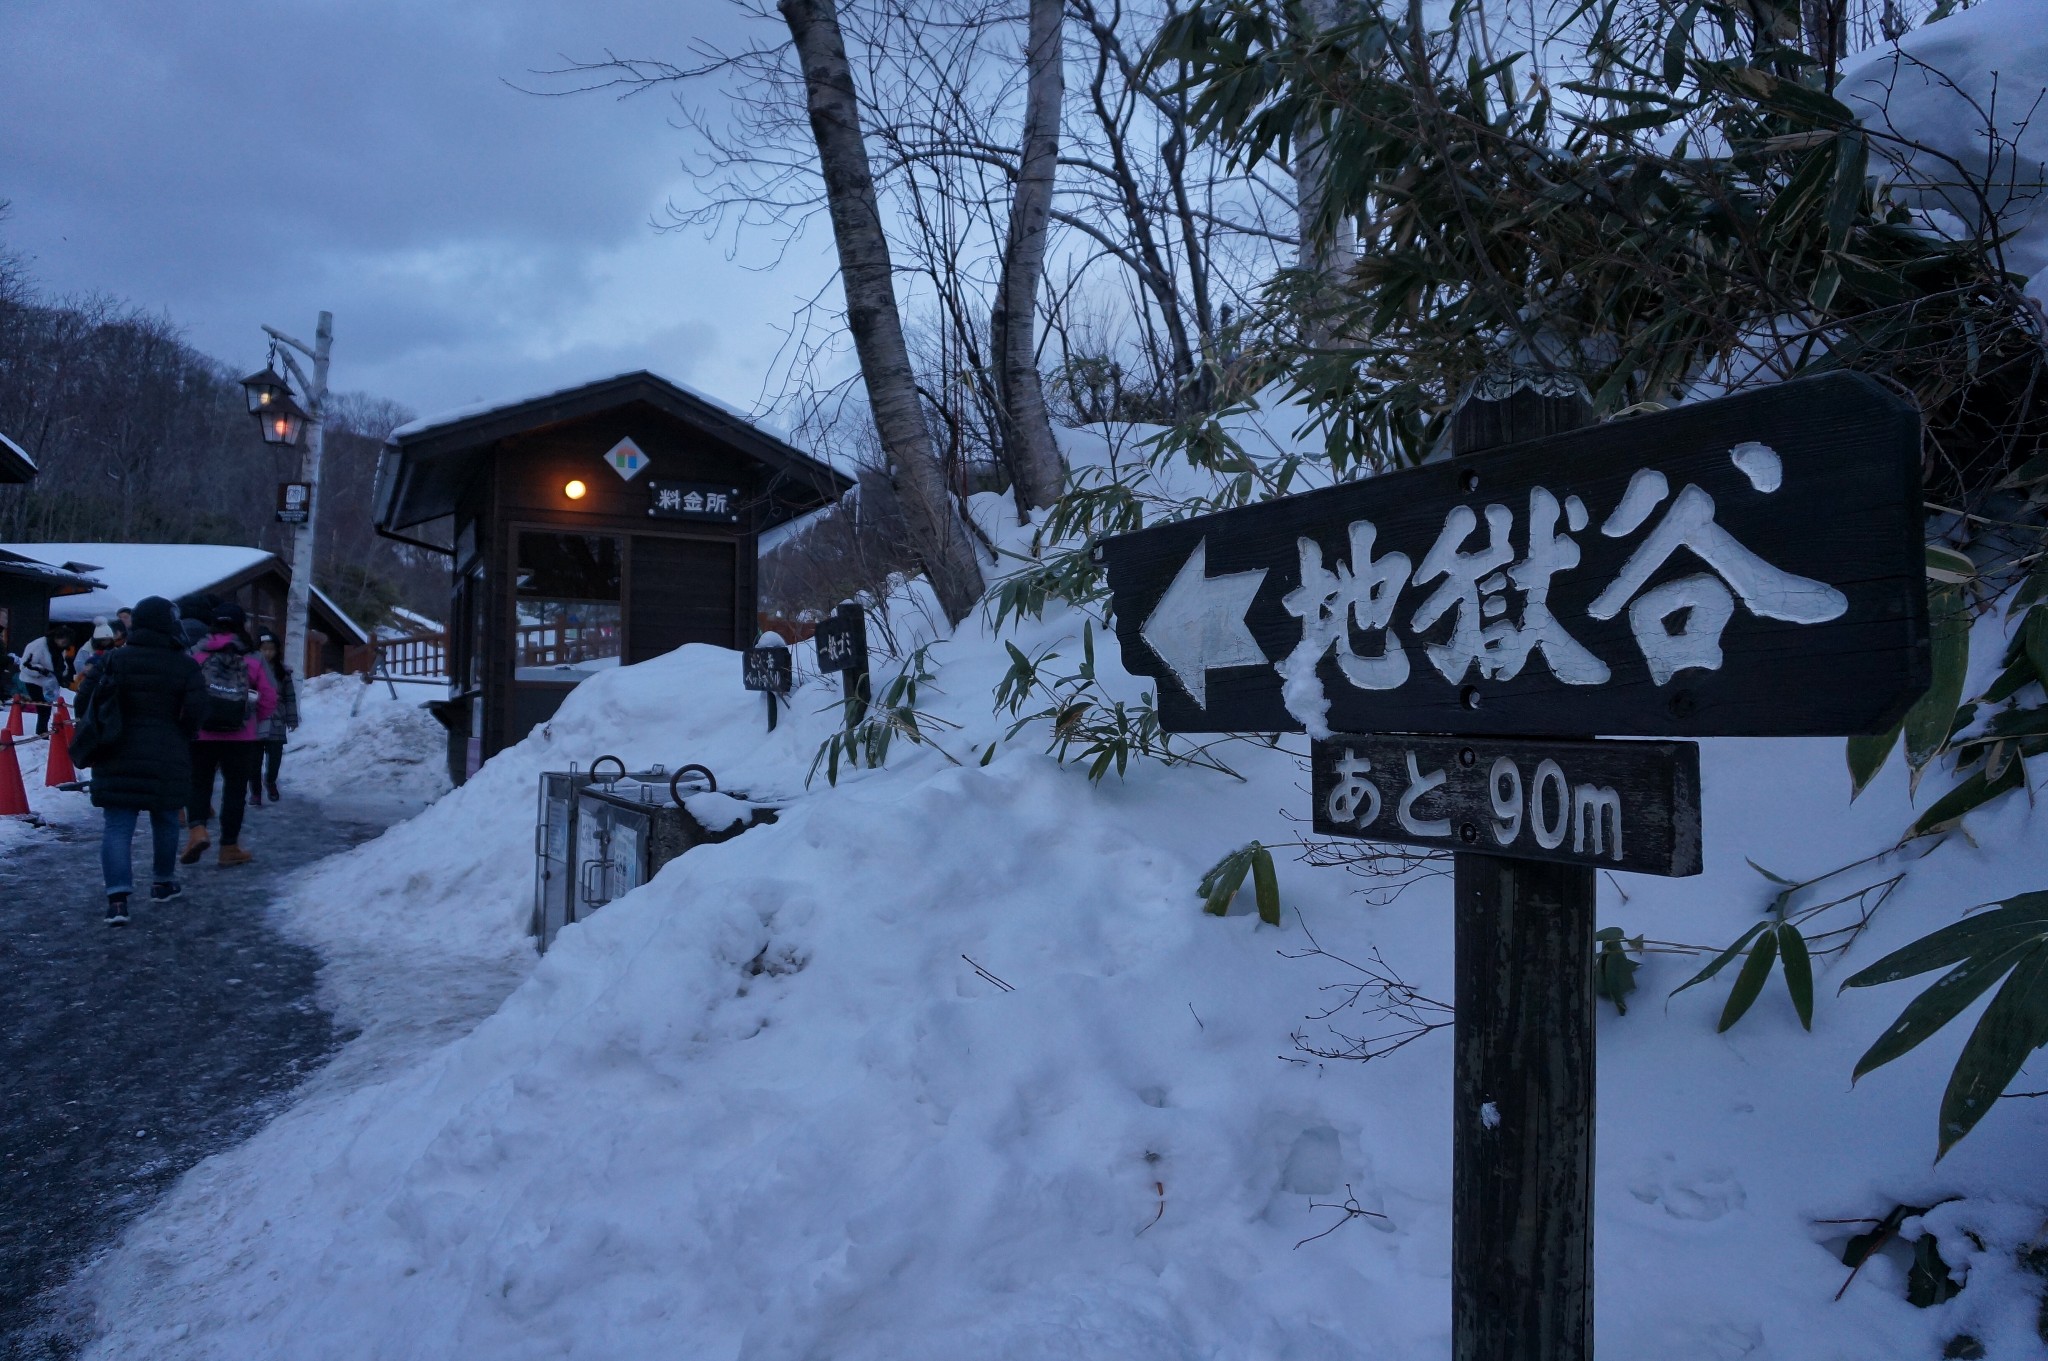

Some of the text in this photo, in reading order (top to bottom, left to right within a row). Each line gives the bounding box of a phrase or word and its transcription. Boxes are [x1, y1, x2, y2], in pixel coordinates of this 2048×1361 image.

[659, 489, 727, 513] 料金所
[1278, 441, 1849, 690] 地獄谷
[1328, 747, 1624, 861] あと 90m
